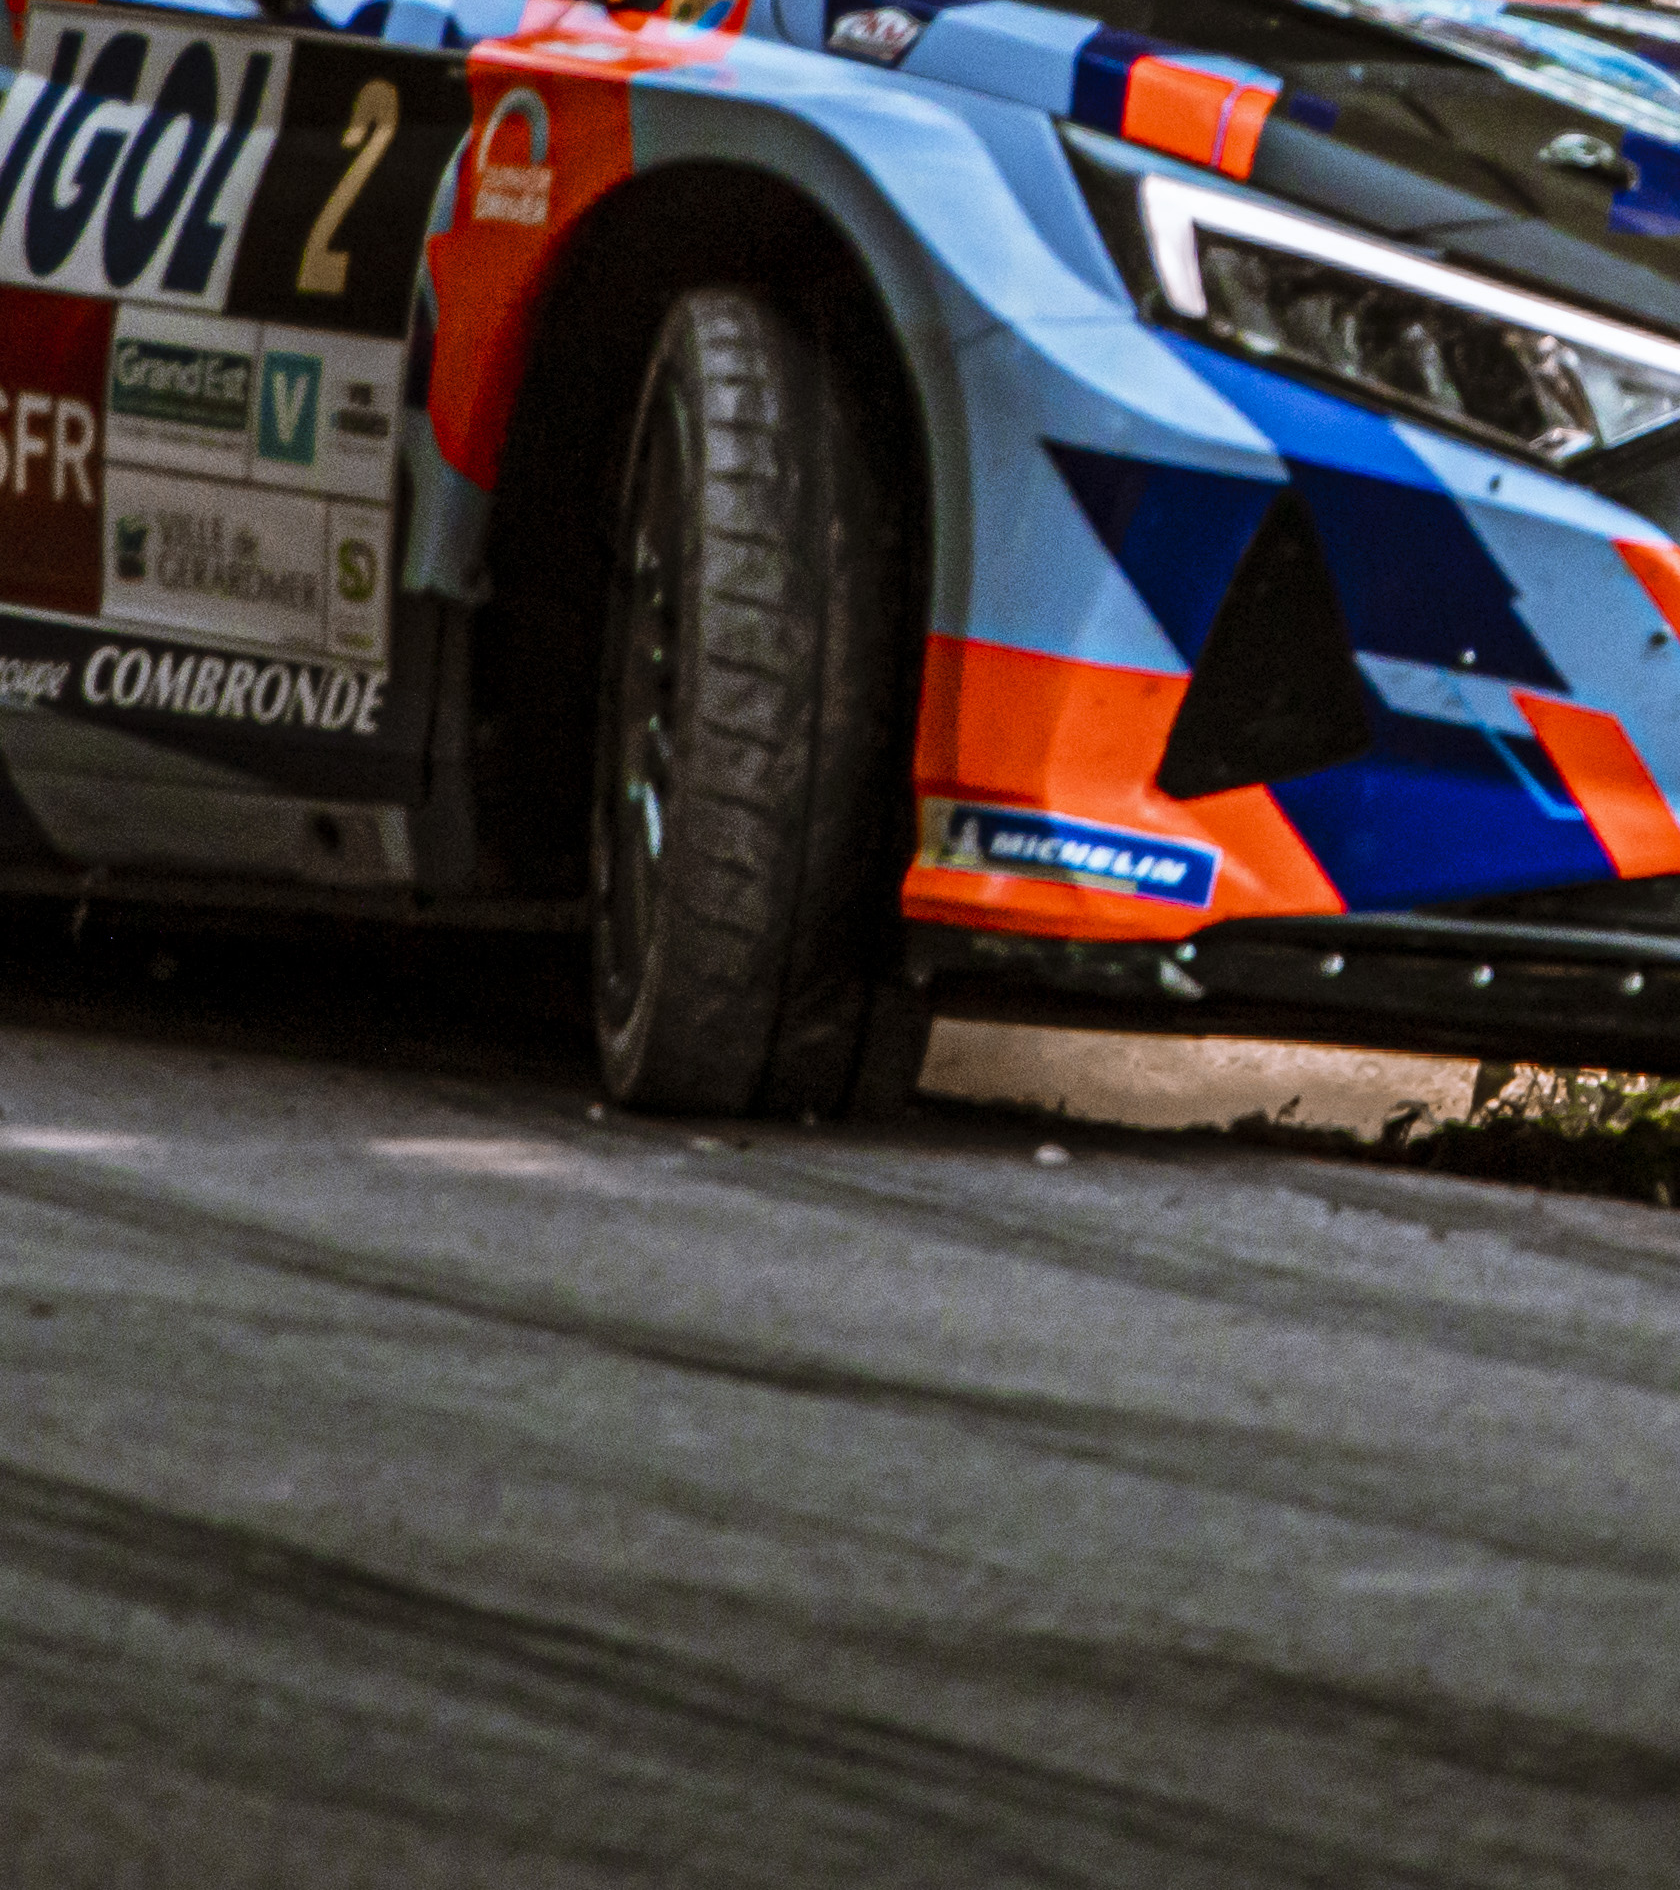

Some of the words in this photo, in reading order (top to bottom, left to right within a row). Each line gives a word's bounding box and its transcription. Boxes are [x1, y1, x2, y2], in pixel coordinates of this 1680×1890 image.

[296, 78, 400, 295] 2
[80, 644, 390, 737] COMBRONDE
[988, 831, 1188, 887] MICHELIN
